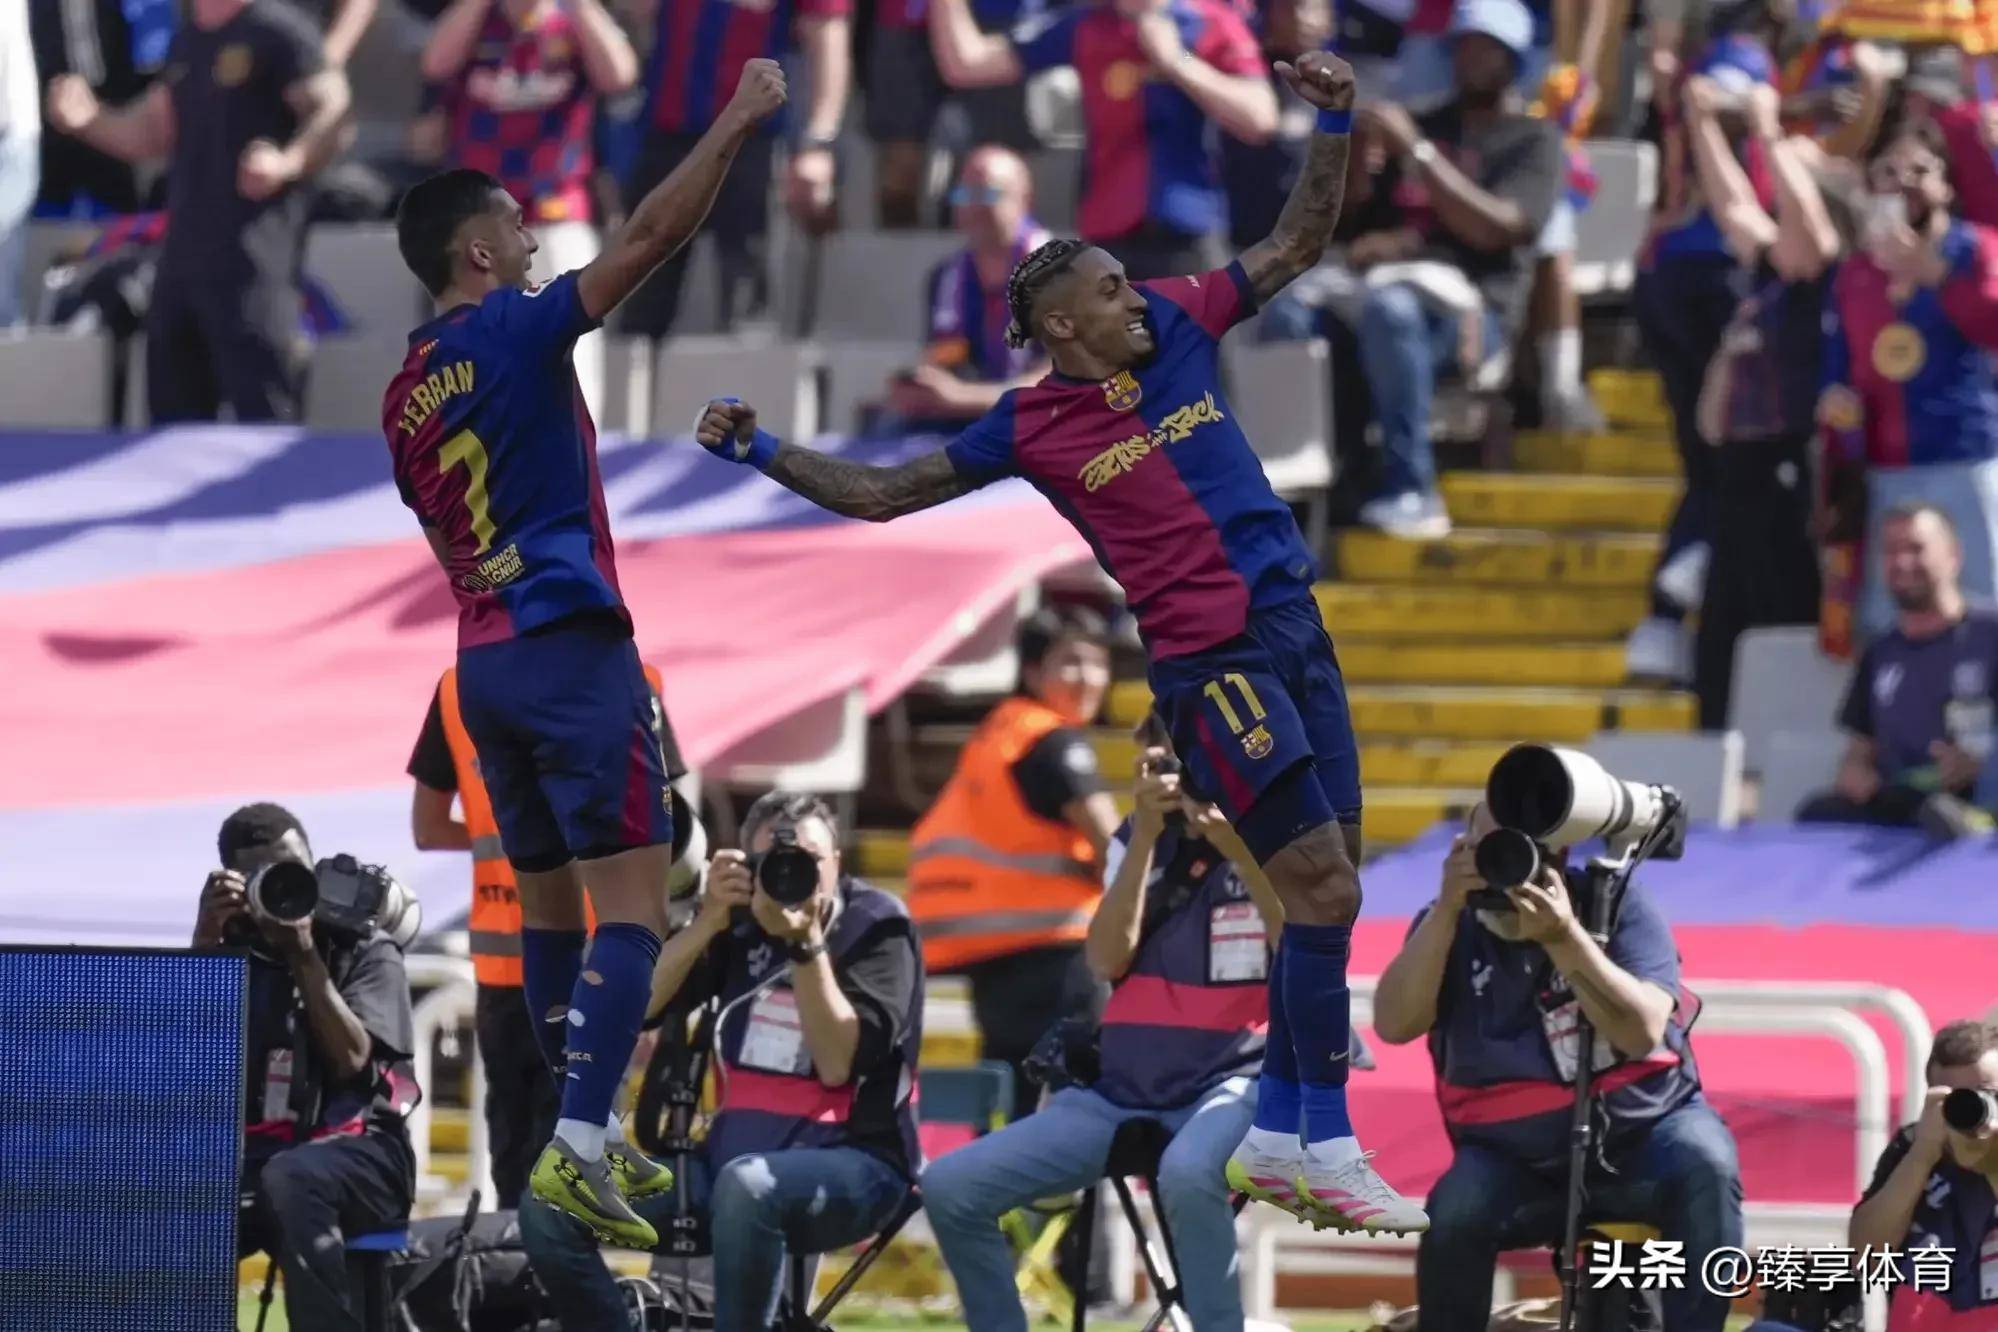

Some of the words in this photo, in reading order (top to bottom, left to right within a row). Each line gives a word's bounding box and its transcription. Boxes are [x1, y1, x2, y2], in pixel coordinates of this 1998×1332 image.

[398, 361, 474, 437] FERRAN
[438, 428, 498, 556] 7
[477, 543, 519, 577] UNHCR
[1203, 673, 1267, 735] 11
